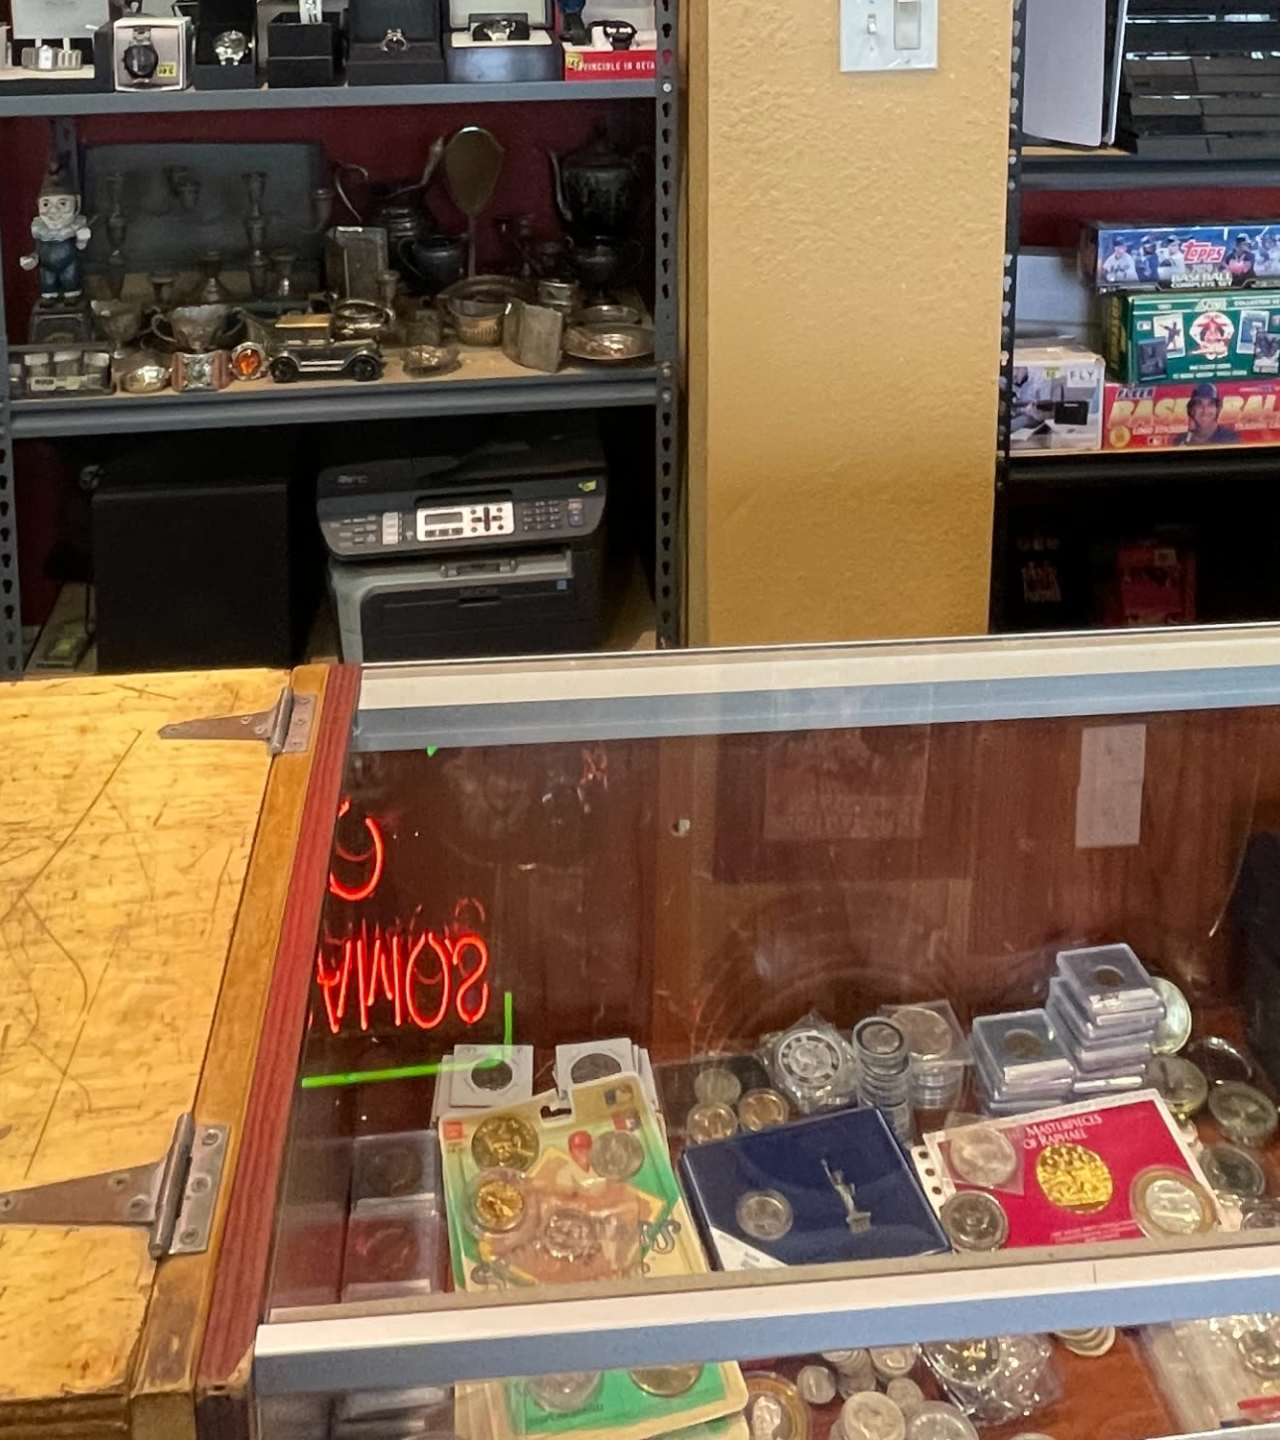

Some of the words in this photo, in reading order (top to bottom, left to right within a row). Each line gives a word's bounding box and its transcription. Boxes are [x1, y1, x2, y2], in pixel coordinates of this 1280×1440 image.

[1069, 369, 1097, 382] FLY
[1024, 1113, 1103, 1138] MASTERPIECES
[1039, 1128, 1088, 1147] RAPHAEL
